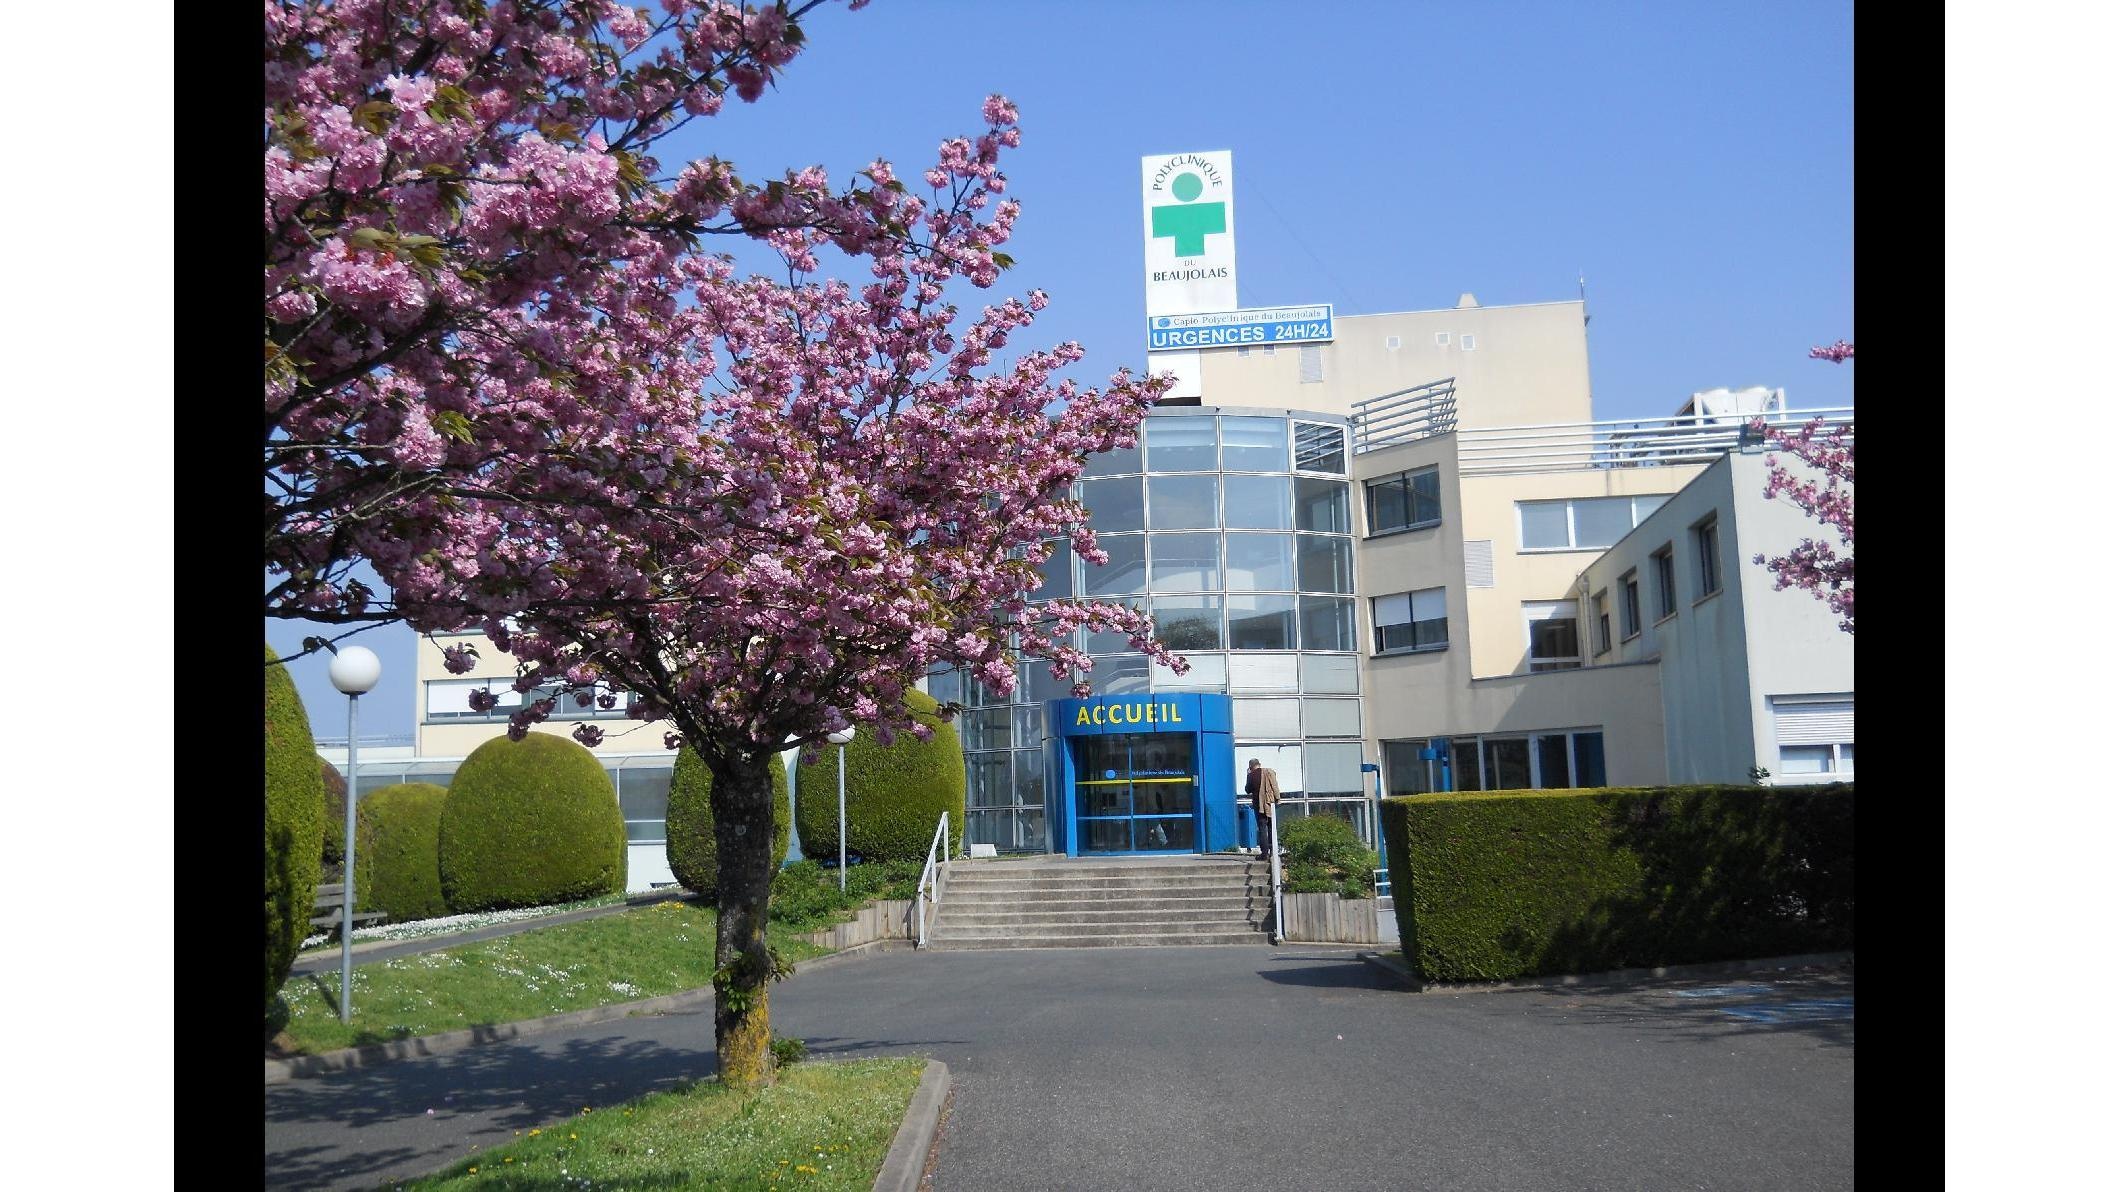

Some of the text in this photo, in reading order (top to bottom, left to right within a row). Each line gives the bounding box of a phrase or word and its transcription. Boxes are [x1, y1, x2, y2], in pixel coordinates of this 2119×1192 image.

[1153, 154, 1223, 191] POLYCLINIQUE
[1153, 267, 1228, 282] BEAUJOLAIS
[1174, 316, 1199, 326] Capio
[1153, 322, 1329, 347] URGENCES 24H/24
[1076, 703, 1182, 726] ACCUEIL
